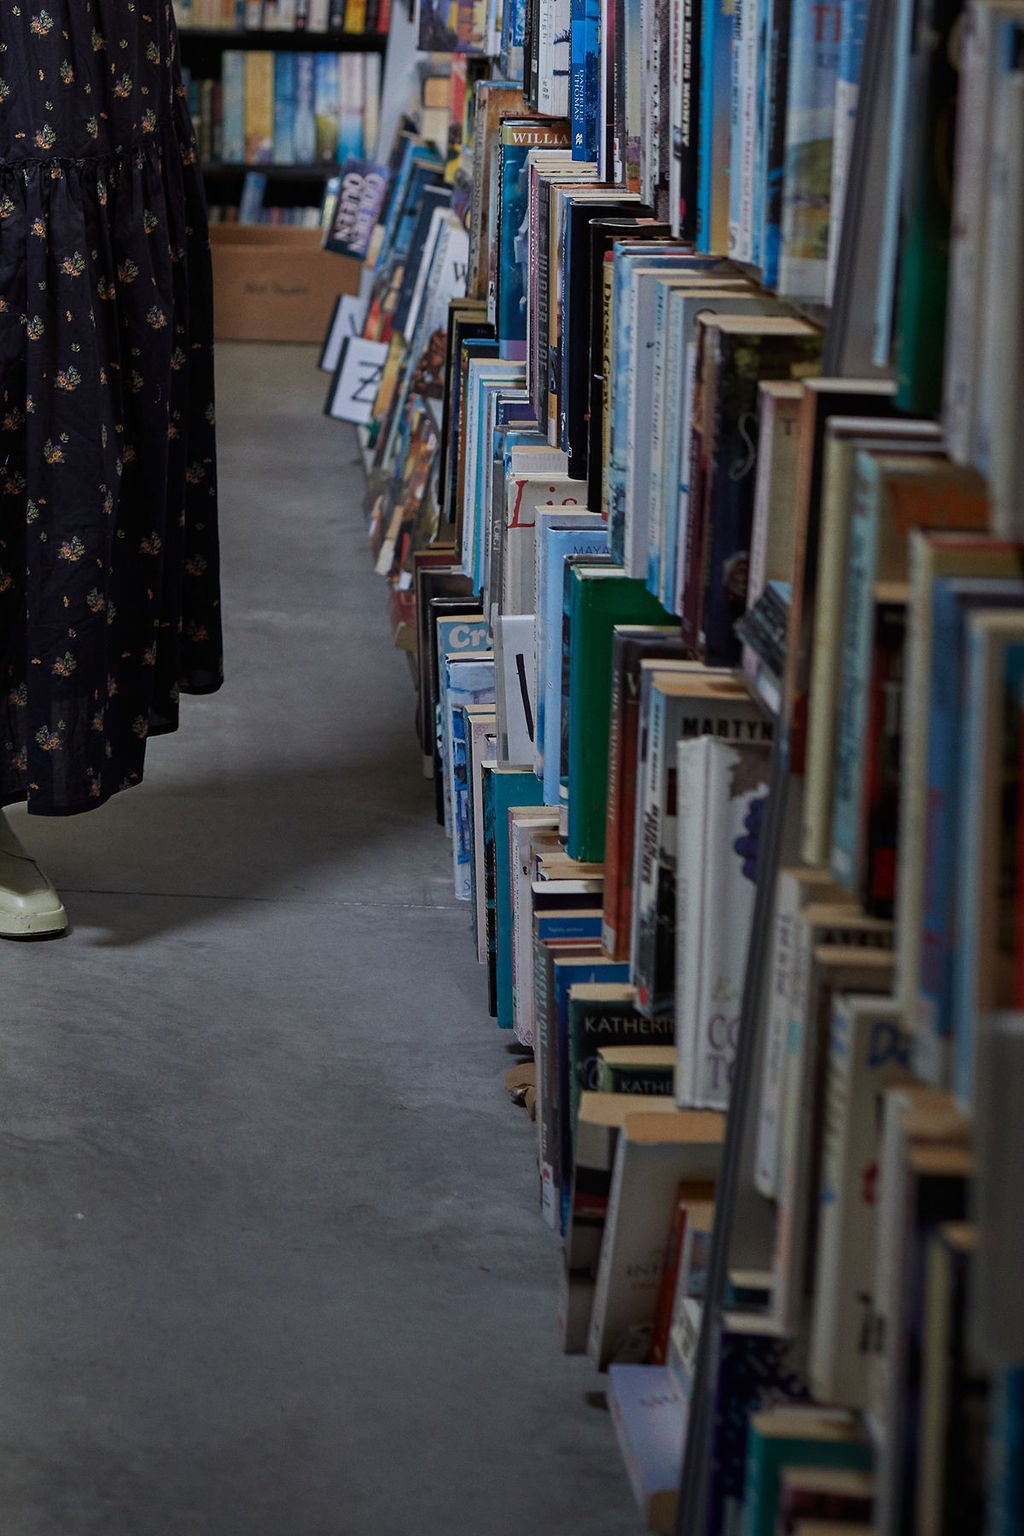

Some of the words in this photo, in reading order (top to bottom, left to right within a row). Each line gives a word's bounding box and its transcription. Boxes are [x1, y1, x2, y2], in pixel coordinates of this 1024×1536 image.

[542, 12, 550, 47] light
[682, 83, 690, 147] MONEY
[513, 131, 569, 144] WILLIA
[474, 154, 483, 208] SECOND
[334, 173, 364, 240] QUEEN
[682, 717, 772, 739] MARTYN
[584, 1016, 675, 1035] KATHERI
[621, 1081, 673, 1095] KATHE
